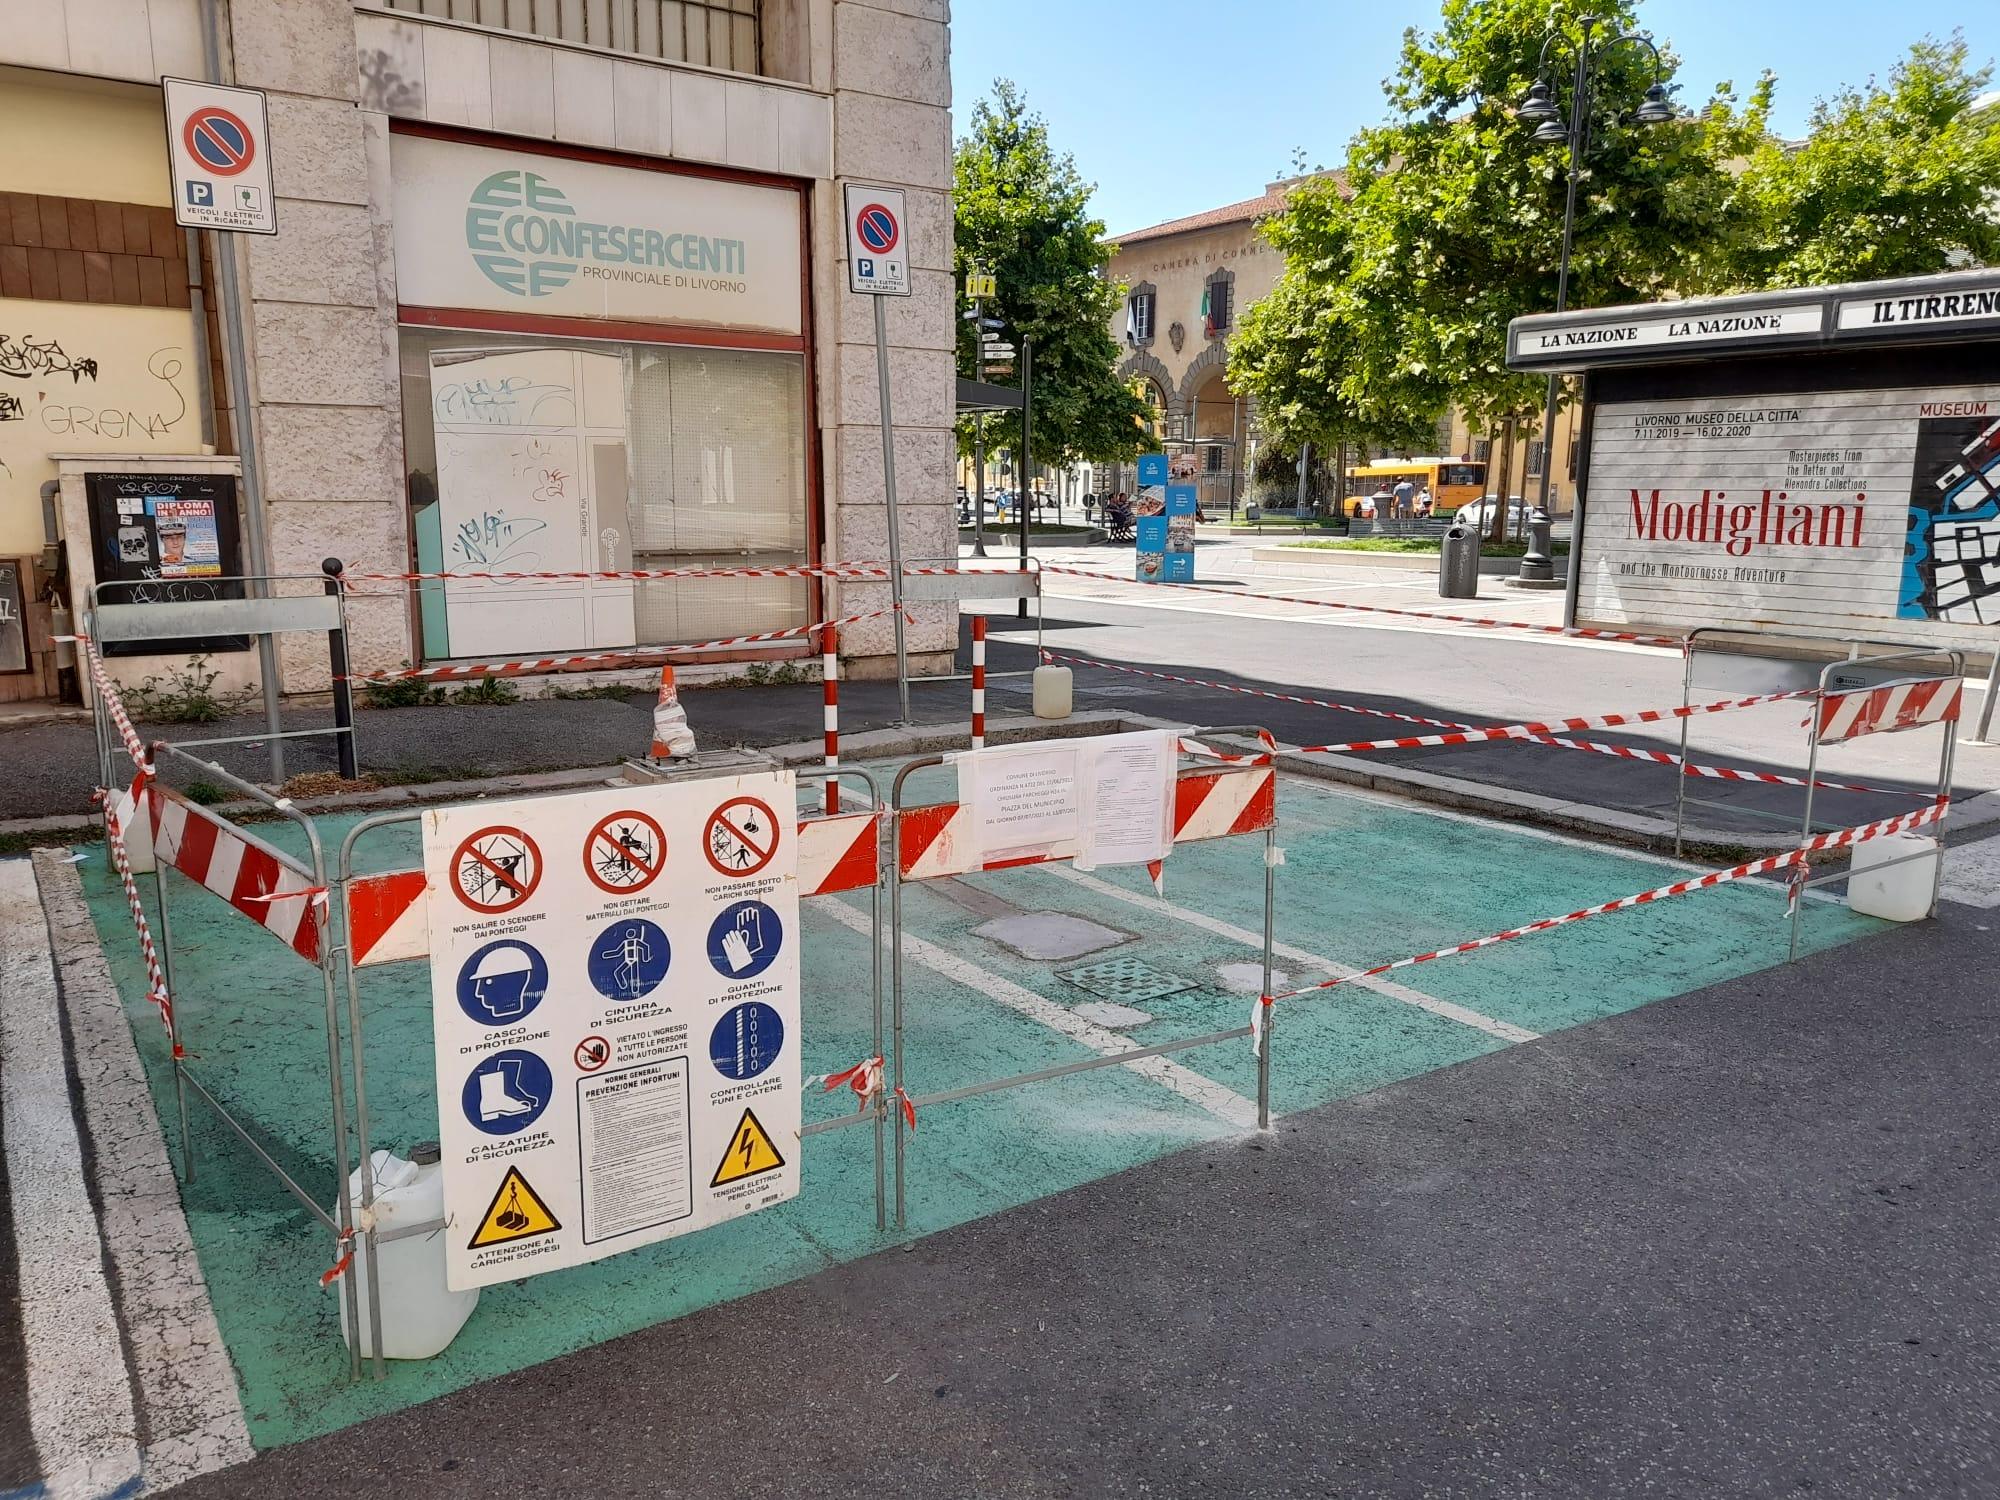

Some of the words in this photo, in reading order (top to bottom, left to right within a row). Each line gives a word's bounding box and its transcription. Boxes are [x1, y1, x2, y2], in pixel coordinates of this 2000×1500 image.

[192, 184, 208, 203] P
[187, 207, 219, 217] VEICOLI
[224, 210, 265, 221] ELETTRICI
[214, 216, 254, 226] RICARICA
[503, 214, 745, 275] CONFESERCENTI
[861, 260, 871, 276] P
[583, 266, 671, 287] PROVINCIALE
[675, 276, 688, 288] DI
[691, 278, 746, 293] LIVORNO
[1872, 301, 1896, 323] IL
[1668, 321, 1691, 337] LA
[1696, 315, 1782, 334] NAZIONE
[1540, 335, 1561, 348] LA
[1565, 328, 1638, 346] NAZIONE
[1685, 413, 1724, 425] MUSEO
[1727, 411, 1764, 423] DELLA
[1920, 402, 1987, 417] MUSEUM
[1635, 428, 1680, 440] 7.11.2019
[1697, 425, 1751, 438] 16.02.2020
[1789, 450, 1840, 463] Masterpieces
[1844, 450, 1863, 462] from
[1787, 464, 1799, 476] the
[1831, 464, 1845, 476] and
[1824, 478, 1867, 490] Collections
[156, 502, 211, 510] DIPLOMA
[157, 509, 168, 517] IN
[179, 508, 212, 517] ANNO!
[1626, 489, 1866, 557] Modigliani
[1620, 563, 1636, 575] and
[1641, 563, 1657, 575] the
[1734, 566, 1786, 583] Adventure
[1001, 804, 1021, 813] PIAZZA
[1022, 802, 1033, 810] DEL
[705, 886, 720, 894] NON
[723, 881, 756, 892] PASSARE
[758, 877, 782, 886] SOTTO
[713, 891, 742, 901] CARICHI
[744, 886, 774, 897] SOSPESI
[586, 910, 622, 921] MATERIALI
[624, 907, 634, 916] DAI
[636, 903, 670, 914] PONTEGGI
[603, 902, 617, 910] NON
[620, 897, 651, 908] GETTARE
[453, 925, 469, 933] NON
[472, 919, 498, 931] SALIRE
[507, 913, 547, 925] SCENDERE
[475, 931, 487, 939] DAI
[489, 924, 527, 937] PONTEGGI
[709, 997, 718, 1005] DI
[721, 984, 783, 1003] PROTEZIONE
[728, 981, 765, 993] GUANTI
[591, 1020, 602, 1028] DI
[606, 1007, 672, 1025] SICUREZZA
[605, 1002, 658, 1017] CINTURA
[460, 1046, 472, 1055] DI
[476, 1030, 550, 1052] PROTEZIONE
[484, 1027, 527, 1041] CASCO
[617, 1031, 646, 1043] VIETATO
[648, 1024, 688, 1038] L'INGRESSO
[624, 1041, 645, 1052] TUTTE
[657, 1033, 688, 1045] PERSONE
[617, 1054, 634, 1063] NON
[637, 1042, 688, 1059] AUTORIZZATE
[585, 1080, 638, 1098] PREVENZIONE
[641, 1071, 680, 1086] INFORTUNI
[604, 1073, 627, 1084] NORME
[630, 1067, 661, 1079] GENERALI
[710, 1076, 781, 1099] CONTROLLARE
[711, 1095, 734, 1106] FUNI
[745, 1083, 783, 1098] CATENE
[465, 1155, 479, 1164] DI
[482, 1138, 555, 1160] SICUREZZA
[471, 1131, 549, 1154] CALZATURE
[713, 1184, 746, 1199] TENSIONE
[747, 1172, 782, 1188] ELETTRICA
[727, 1184, 770, 1202] PERICOLOSA
[470, 1255, 514, 1270] CARICHI
[516, 1244, 560, 1260] SOSPESI
[476, 1240, 541, 1260] ATTENZIONE
